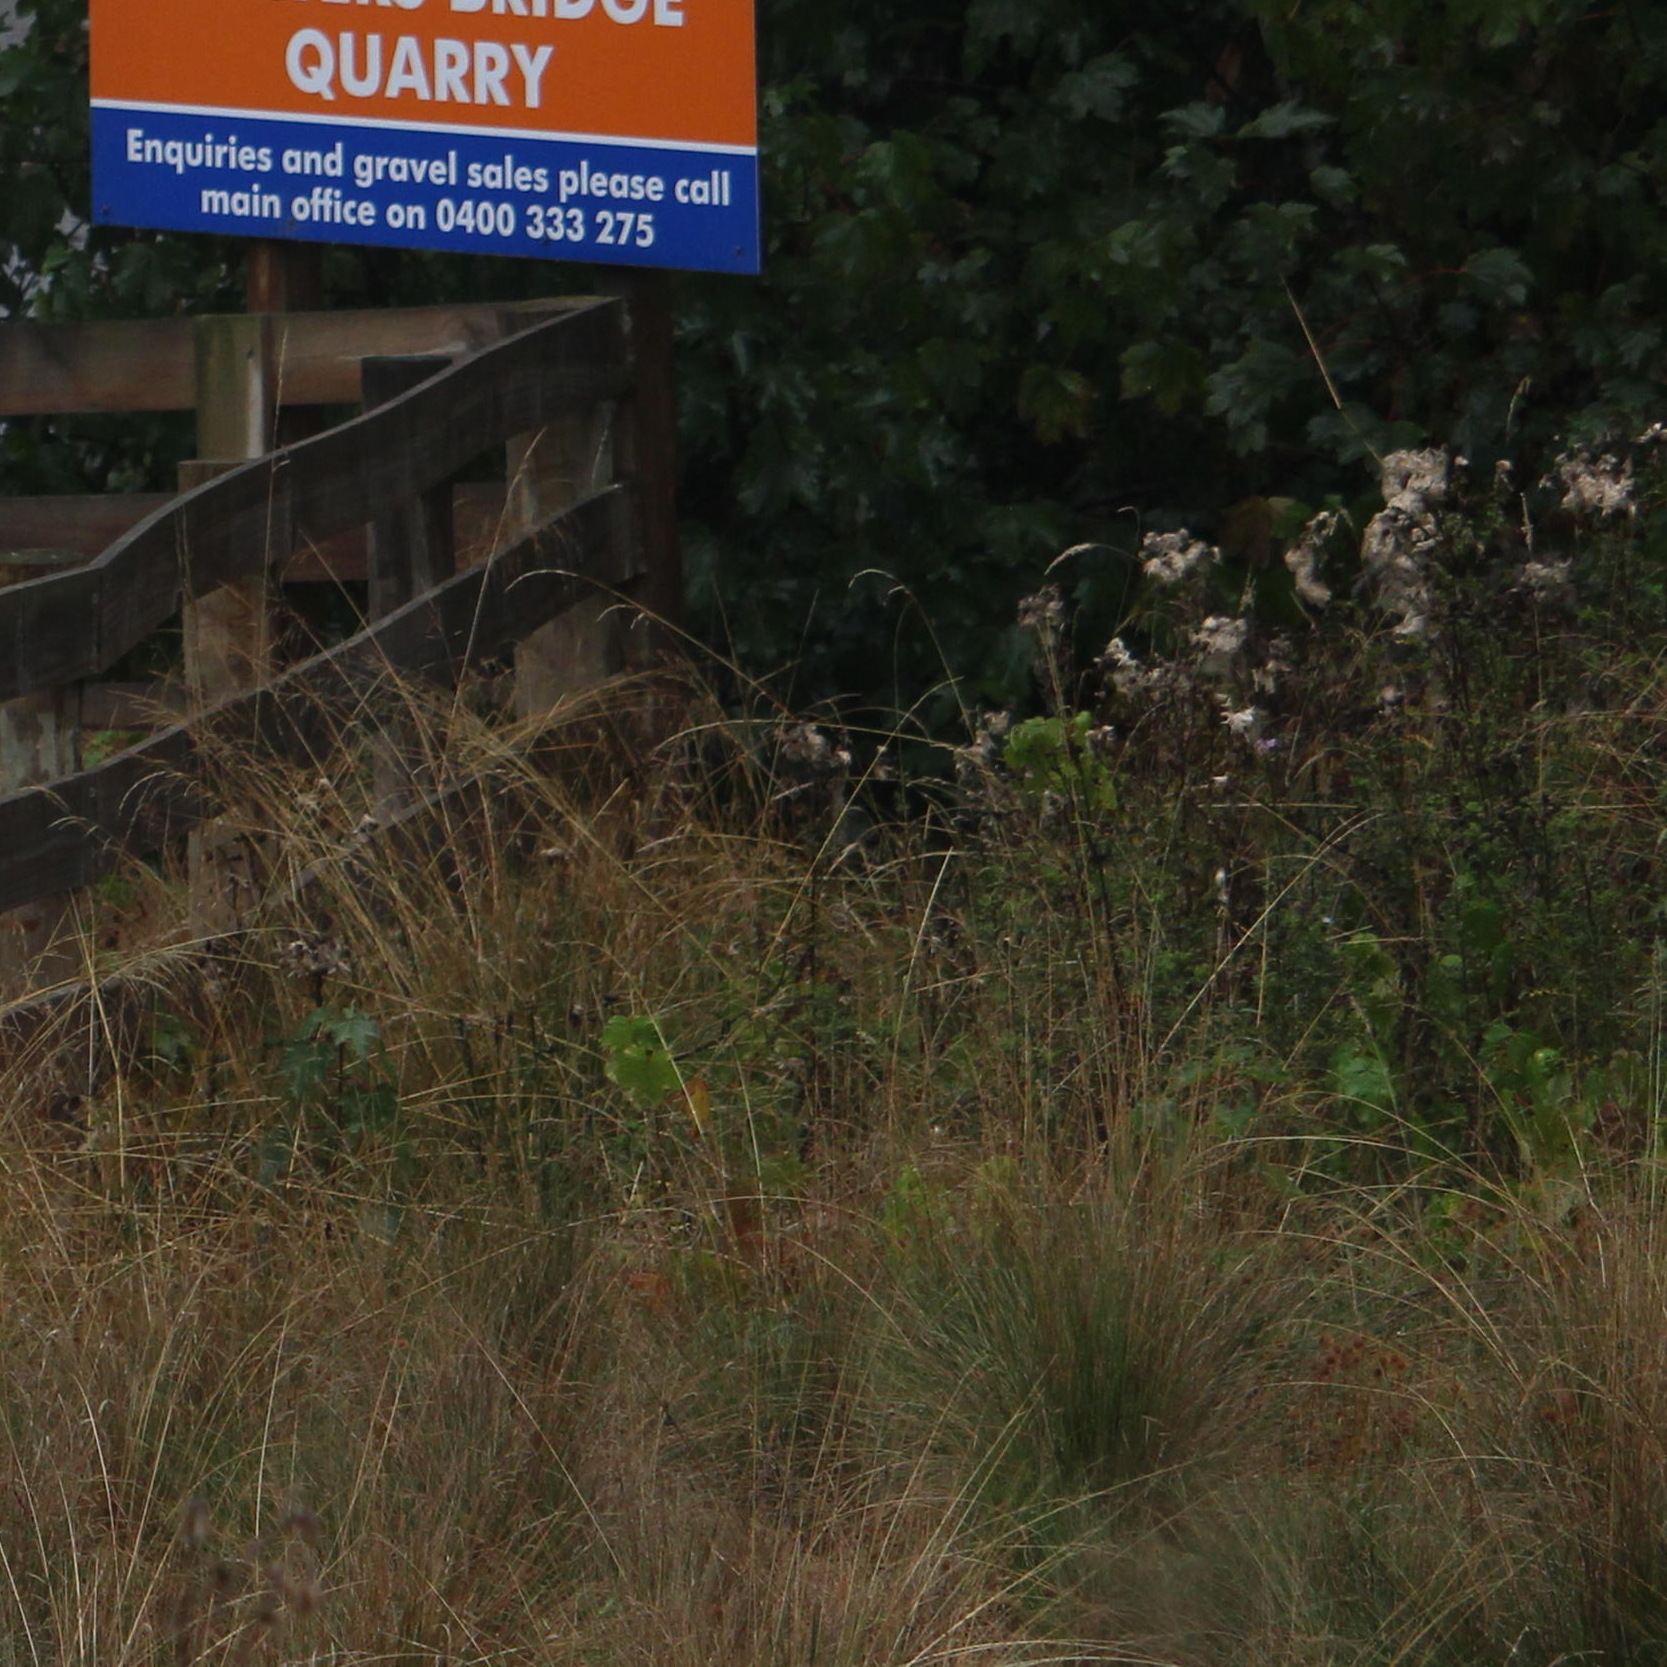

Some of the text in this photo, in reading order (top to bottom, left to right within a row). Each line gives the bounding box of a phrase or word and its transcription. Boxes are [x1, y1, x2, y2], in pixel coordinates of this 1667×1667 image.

[285, 28, 553, 109] QUARRY
[127, 129, 730, 206] Enquiries and gravel sales please call
[201, 183, 654, 248] main office on 0400 333 275
